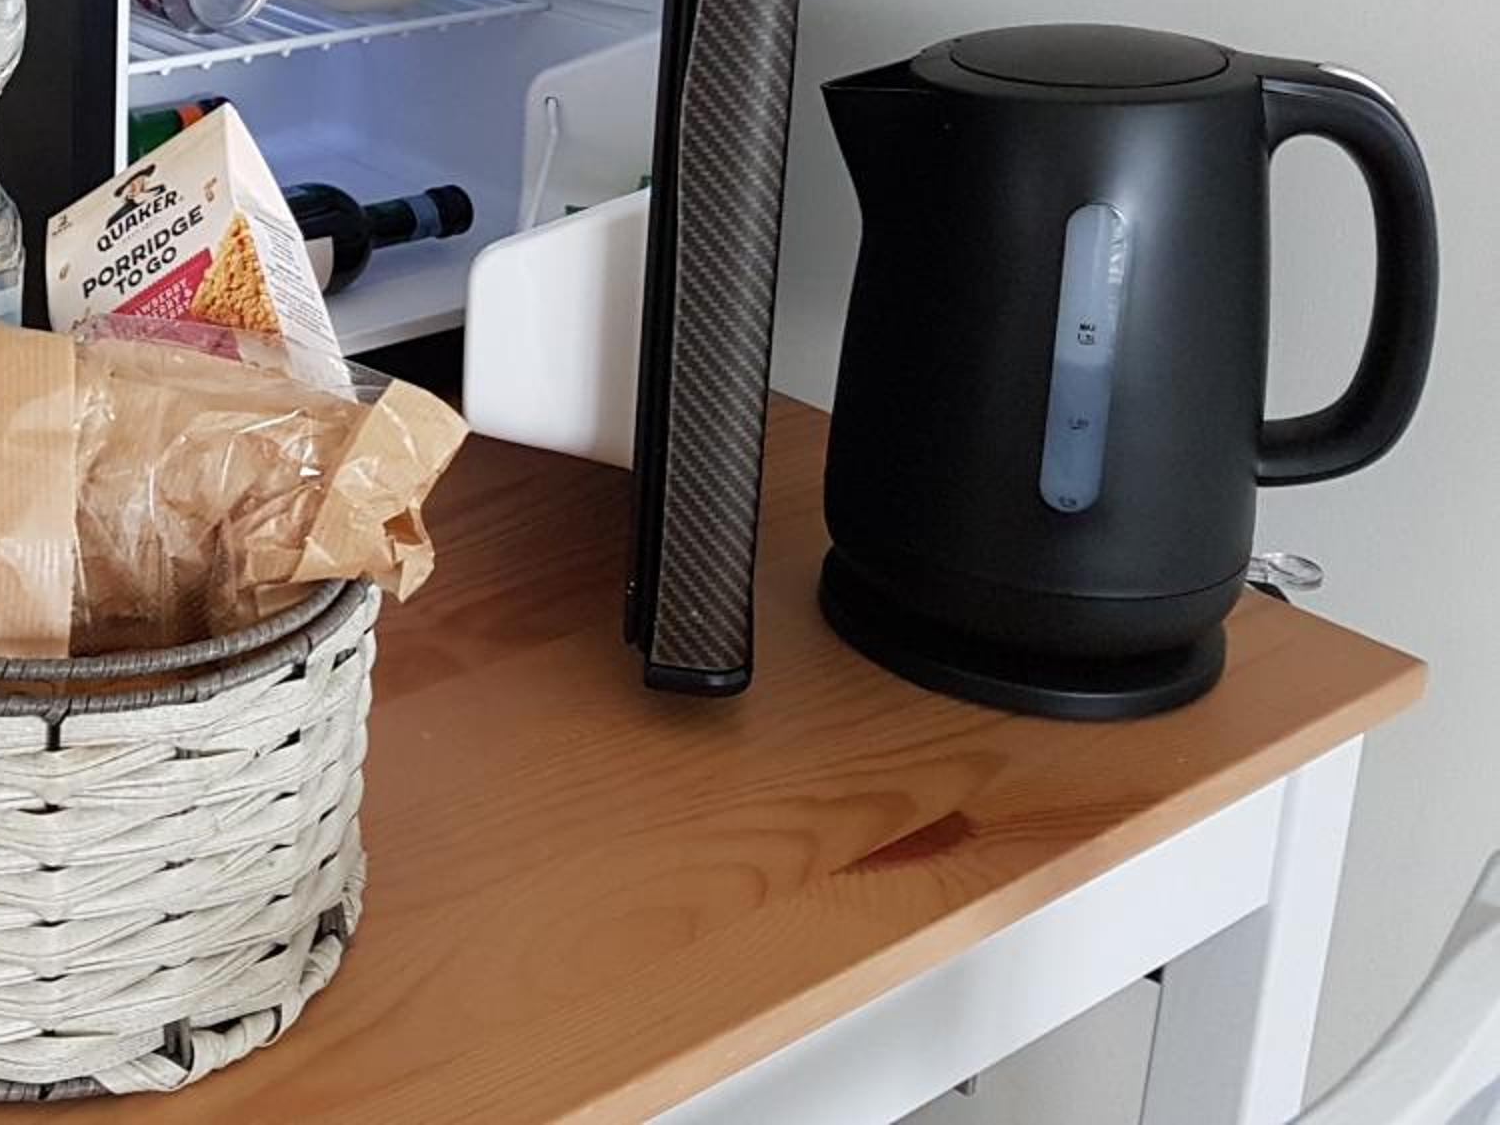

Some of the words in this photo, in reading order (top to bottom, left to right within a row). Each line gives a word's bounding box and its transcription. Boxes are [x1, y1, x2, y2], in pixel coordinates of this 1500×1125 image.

[82, 205, 204, 299] PORRIDGE
[96, 190, 178, 252] QUAKER
[113, 269, 143, 296] TO
[145, 246, 178, 274] GO
